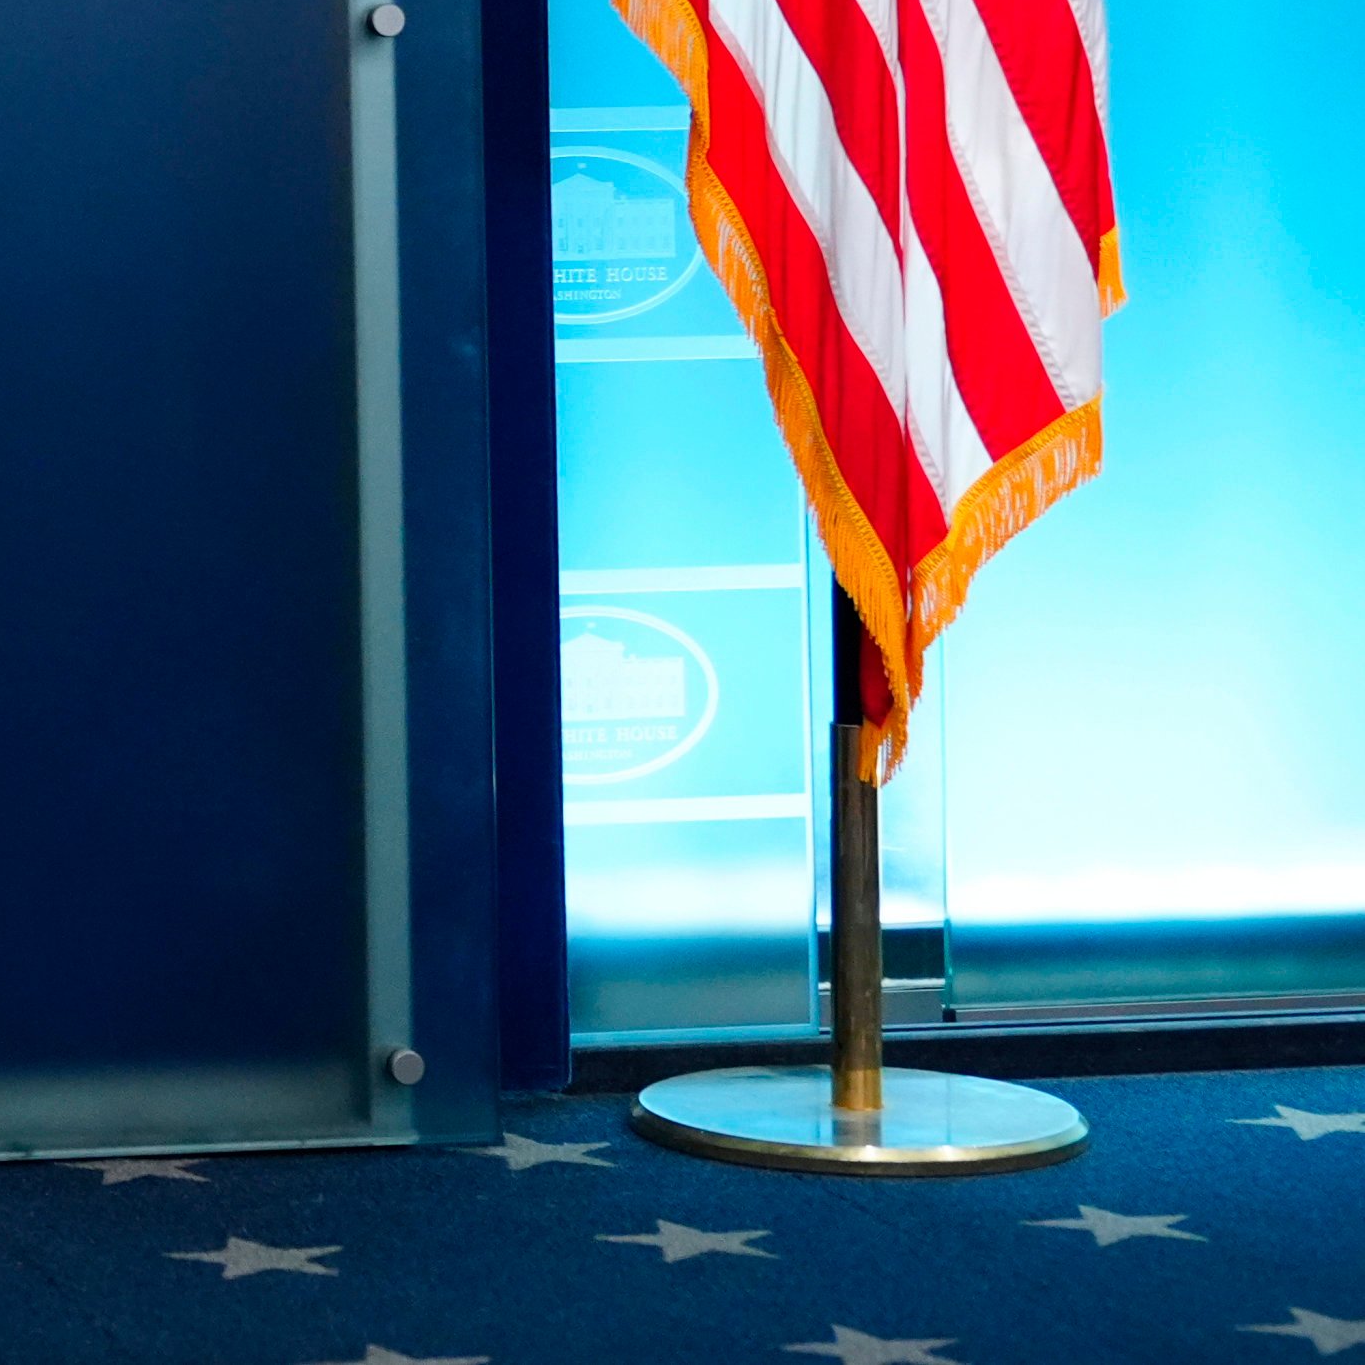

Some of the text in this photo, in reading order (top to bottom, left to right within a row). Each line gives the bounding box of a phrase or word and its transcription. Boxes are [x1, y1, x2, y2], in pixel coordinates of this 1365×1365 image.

[553, 266, 669, 284] HITE HOUSE
[562, 724, 678, 744] HITE HOUSE
